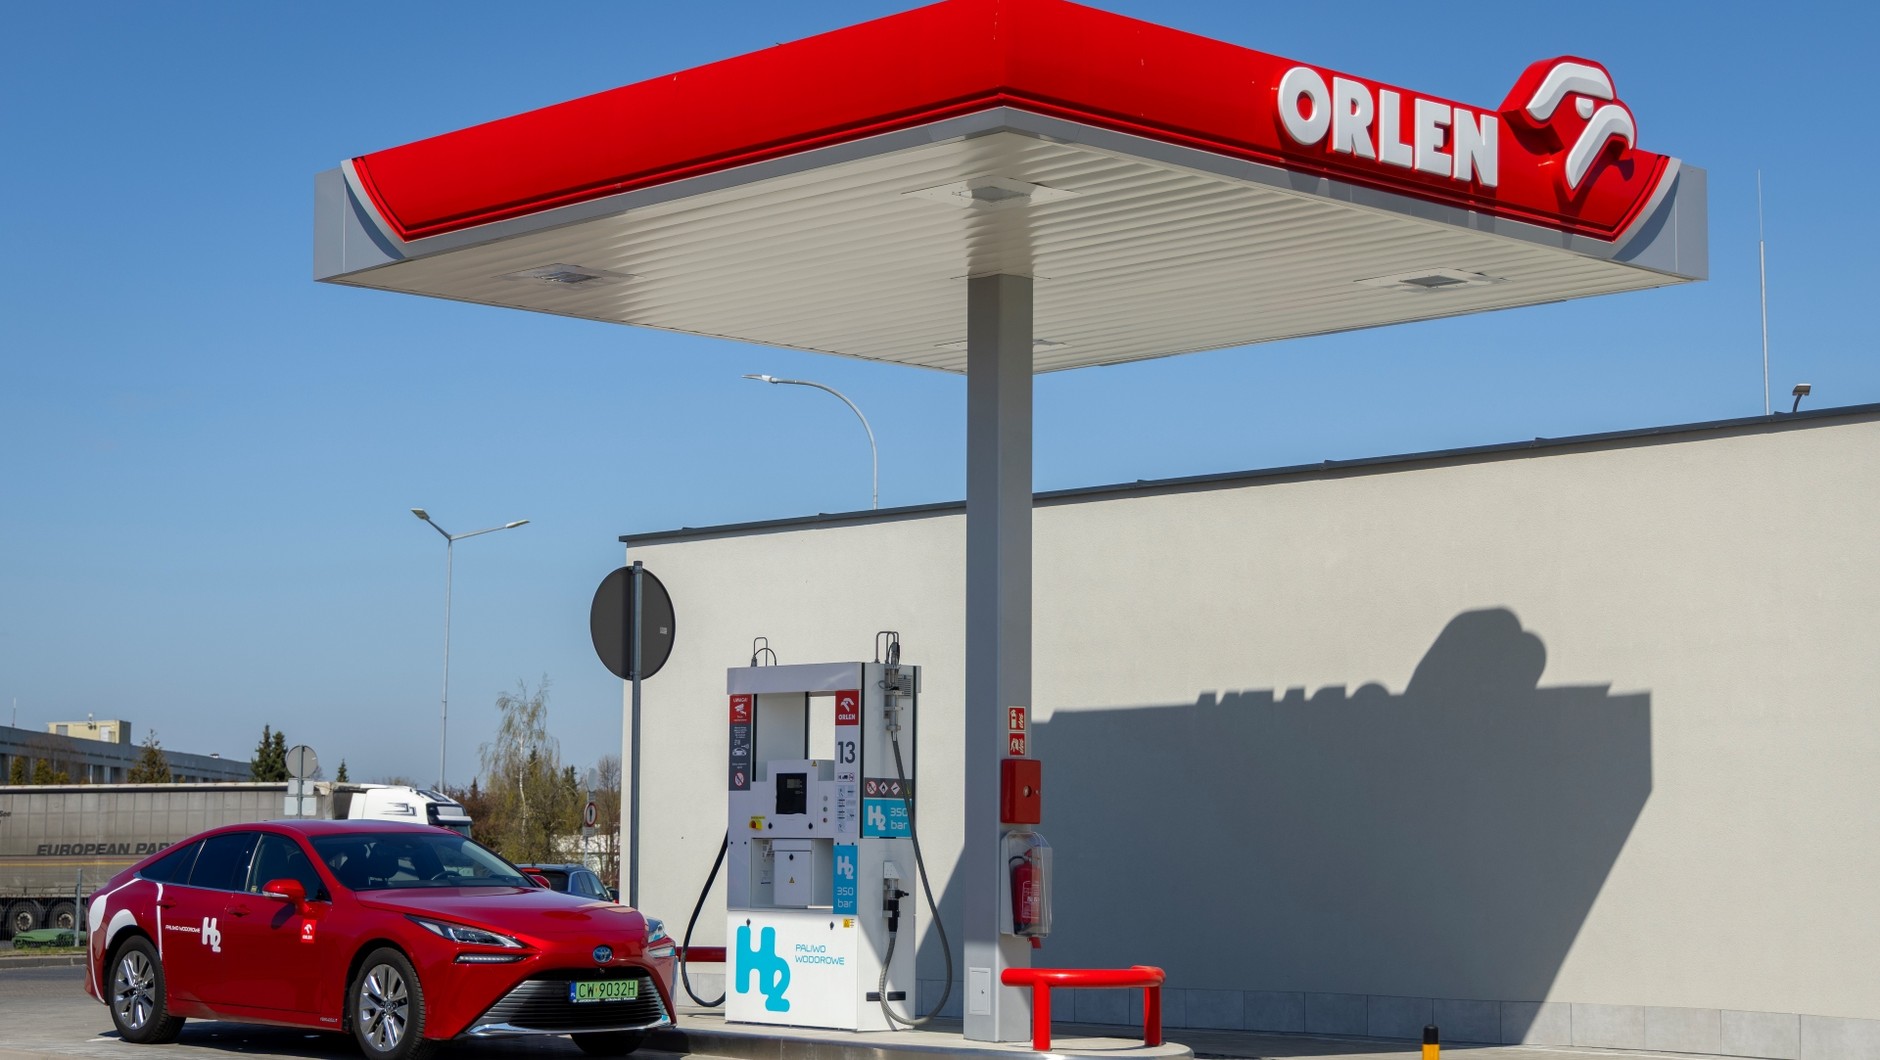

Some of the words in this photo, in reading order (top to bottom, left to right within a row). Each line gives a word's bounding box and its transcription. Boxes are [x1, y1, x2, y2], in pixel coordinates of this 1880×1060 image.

[1277, 66, 1498, 188] ORLEN
[837, 741, 856, 764] 13
[867, 805, 886, 831] H2
[890, 807, 908, 817] 350
[890, 820, 908, 830] bar
[36, 843, 131, 856] EUROPEAN
[837, 855, 854, 880] H2
[837, 886, 854, 896] 350
[837, 898, 853, 908] bar
[795, 943, 827, 953] PALIWO
[795, 955, 845, 965] WODOROWE
[735, 925, 791, 1012] H2
[579, 983, 594, 998] CW
[599, 981, 636, 997] 9032H
